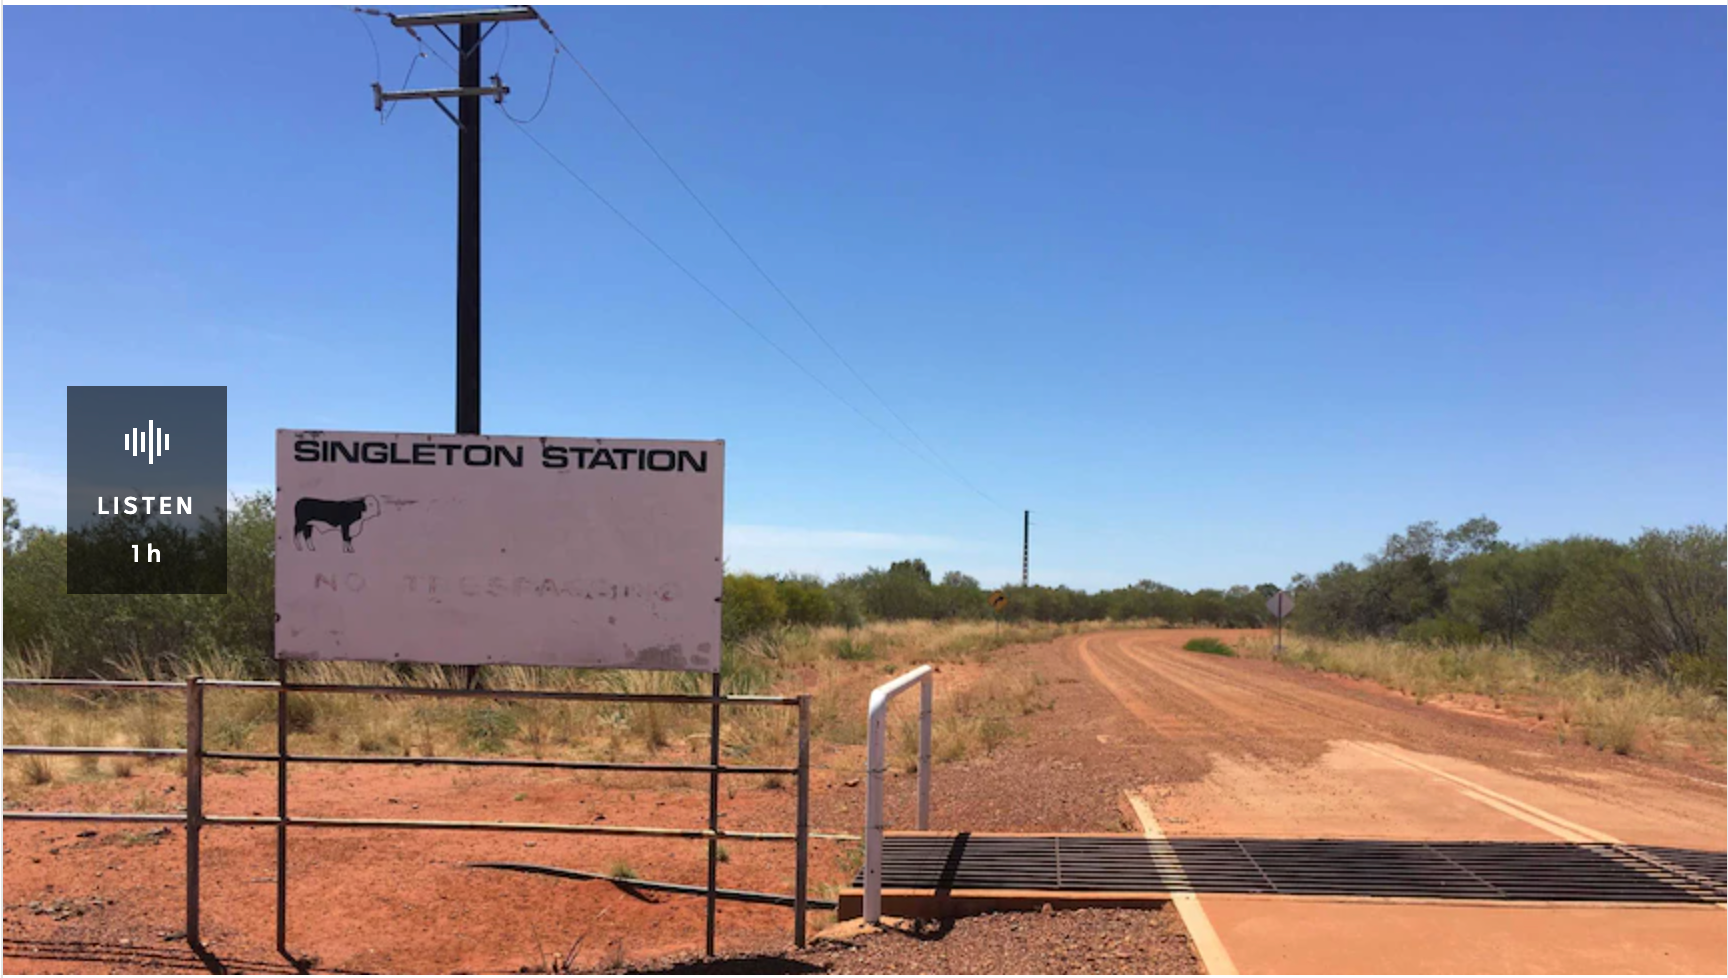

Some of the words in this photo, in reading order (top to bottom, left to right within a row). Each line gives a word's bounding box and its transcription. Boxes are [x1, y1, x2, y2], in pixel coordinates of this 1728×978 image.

[293, 439, 525, 468] SINGLETON
[541, 446, 709, 473] STATION
[314, 572, 367, 593] NO
